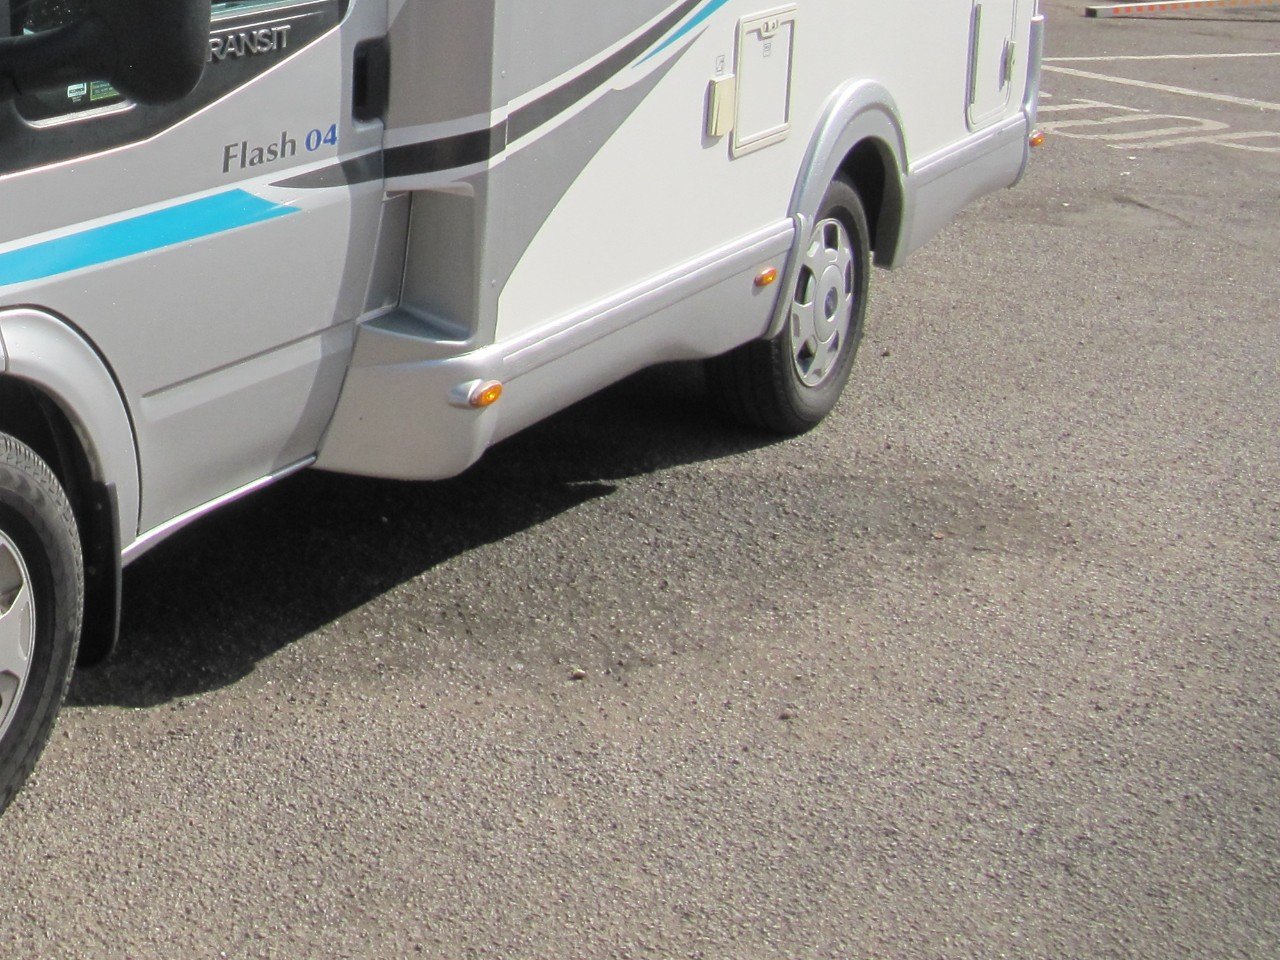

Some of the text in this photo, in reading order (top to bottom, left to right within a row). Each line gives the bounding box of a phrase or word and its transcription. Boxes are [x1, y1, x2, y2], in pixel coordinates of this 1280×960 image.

[208, 24, 291, 61] RANSIT
[222, 123, 338, 173] Flash 04
